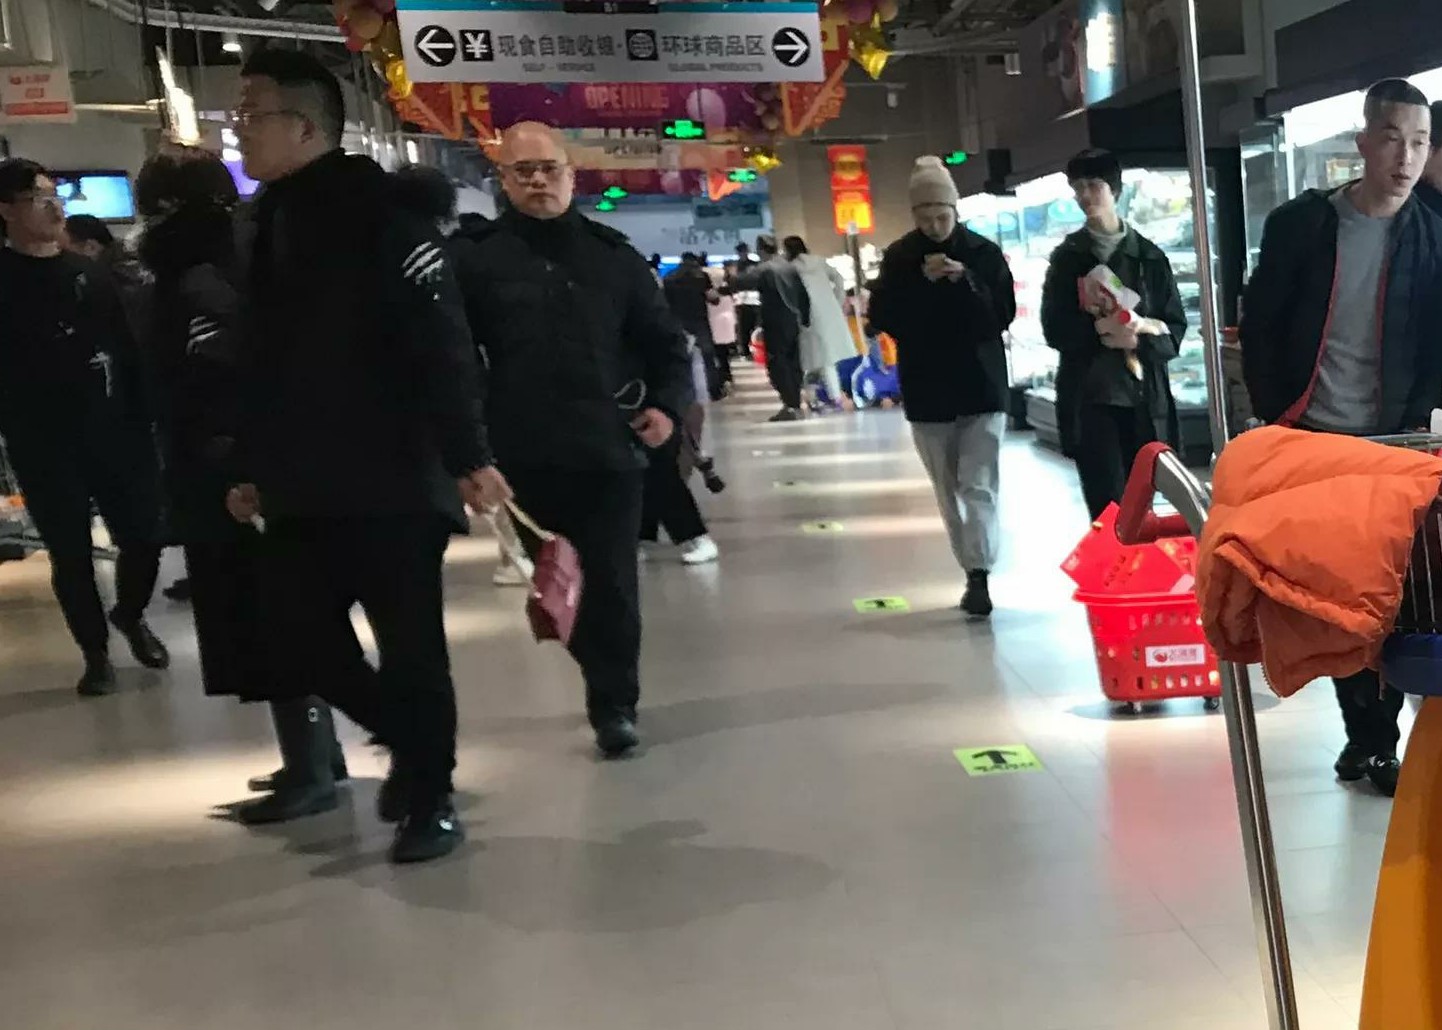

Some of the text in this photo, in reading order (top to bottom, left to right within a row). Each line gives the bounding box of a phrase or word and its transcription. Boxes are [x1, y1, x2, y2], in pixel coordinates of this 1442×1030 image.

[661, 35, 766, 57] 环球商品区
[585, 84, 669, 109] OPENING
